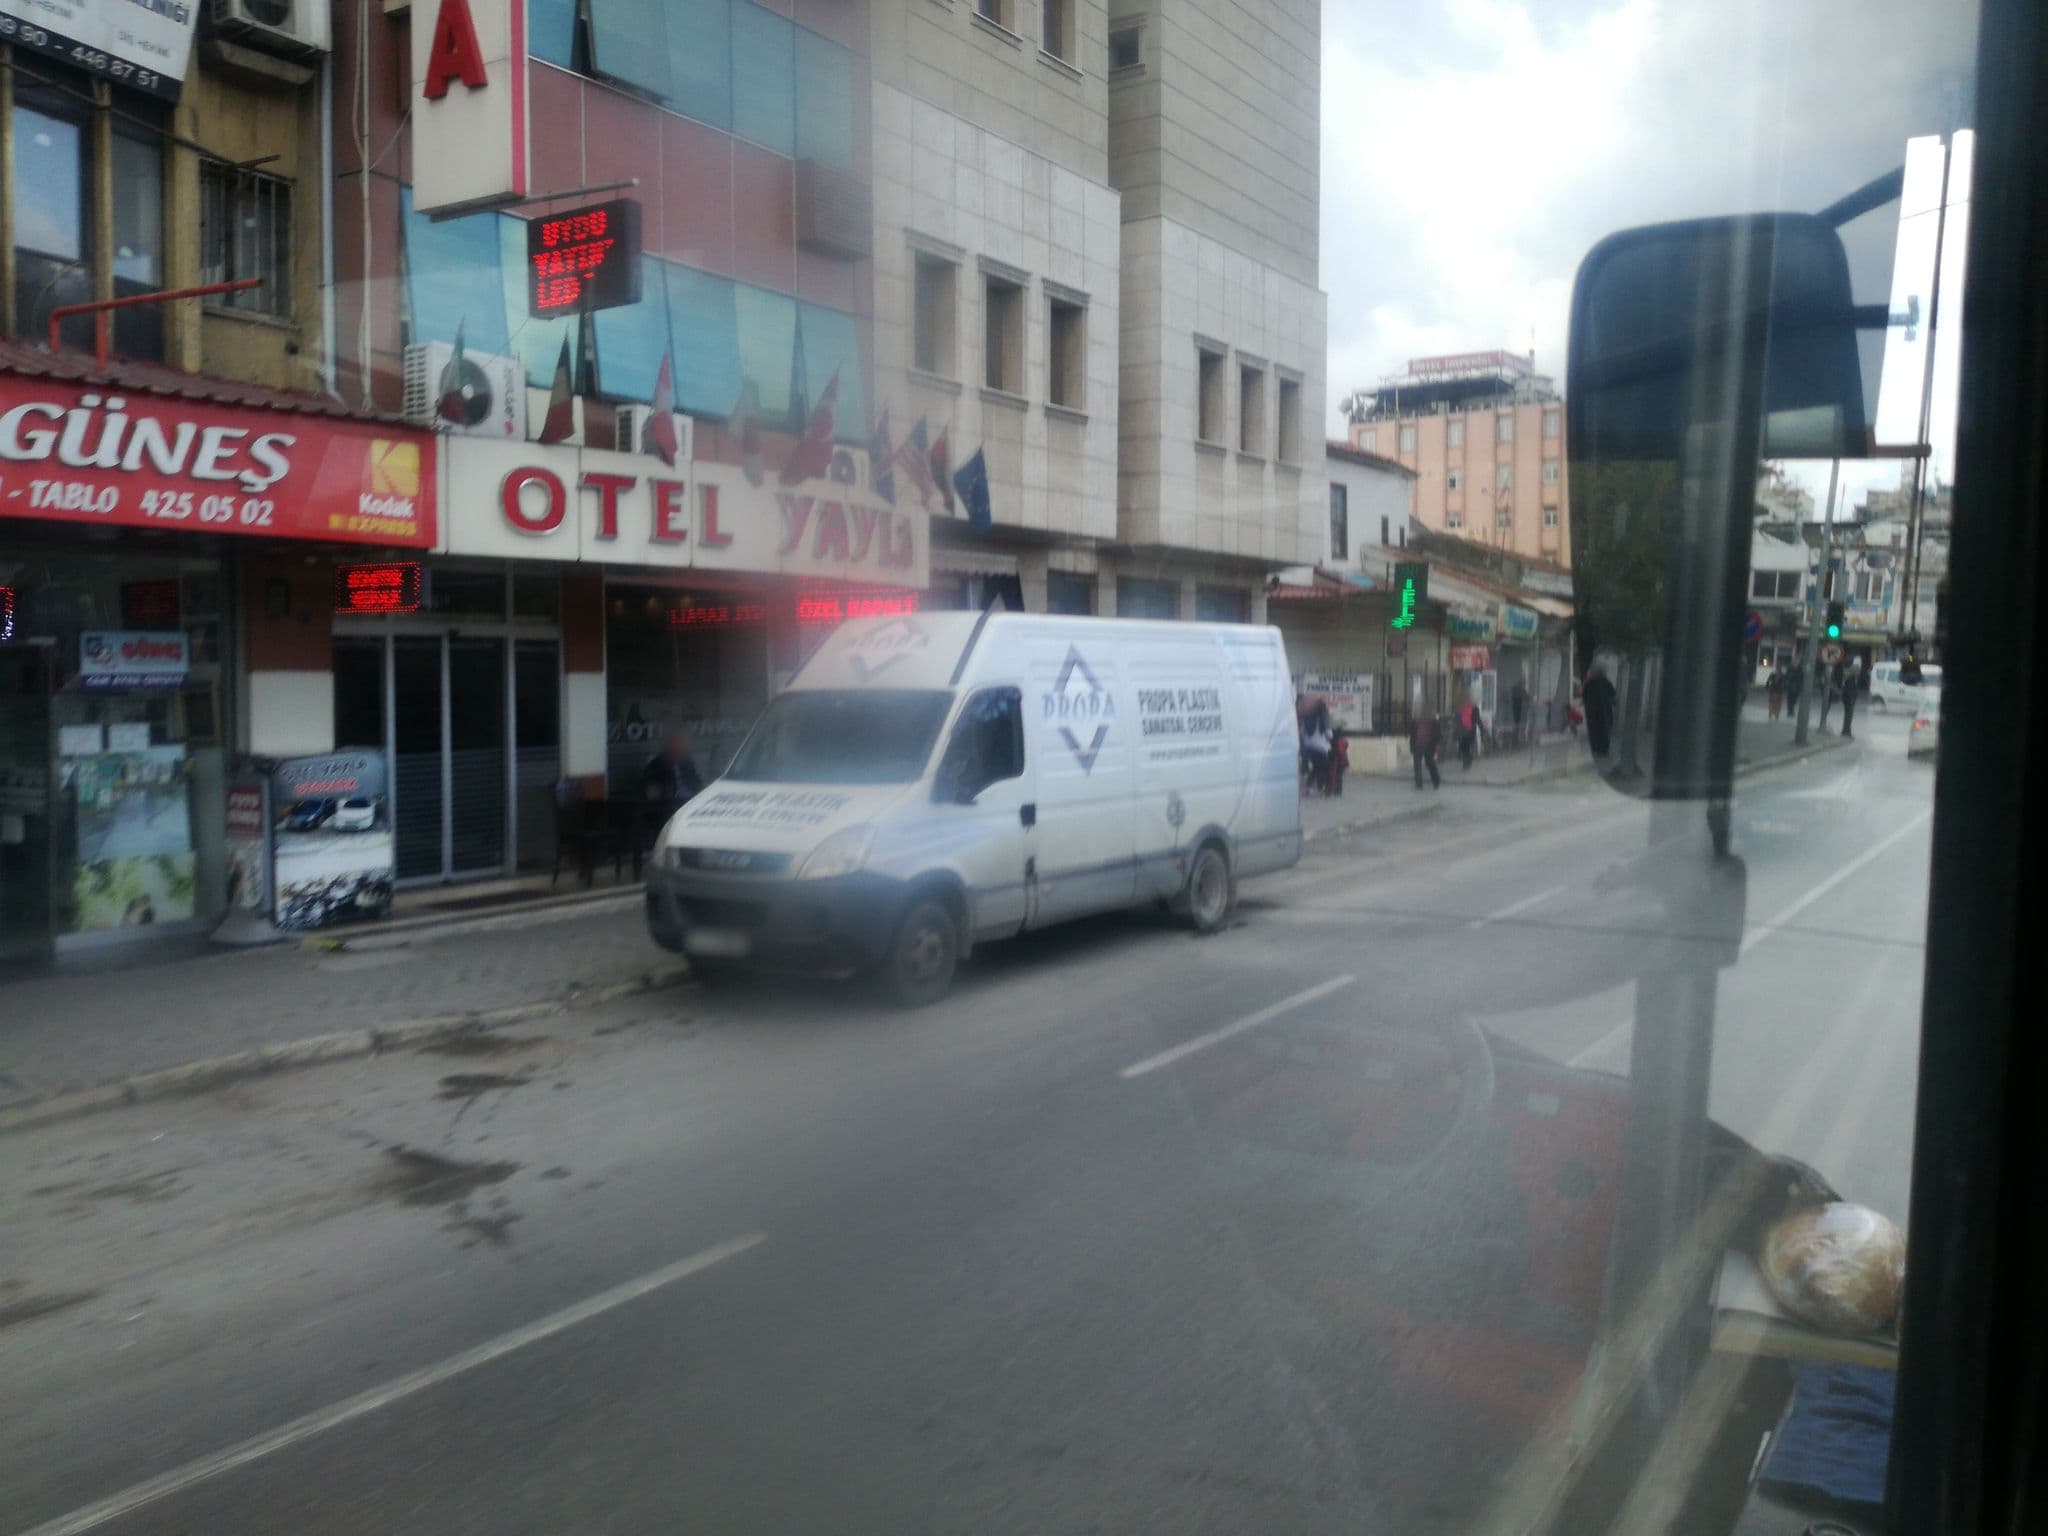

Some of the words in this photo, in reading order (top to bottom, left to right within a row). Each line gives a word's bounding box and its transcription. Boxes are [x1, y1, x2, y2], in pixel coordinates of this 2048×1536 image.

[0, 394, 297, 494] GÜNEŞ
[29, 479, 119, 513] TABLO
[139, 488, 193, 520] 425
[199, 496, 234, 525] 05
[239, 500, 275, 527] 02
[359, 493, 414, 518] Kodak
[500, 466, 733, 548] OTEL
[1138, 689, 1176, 714] PROPA
